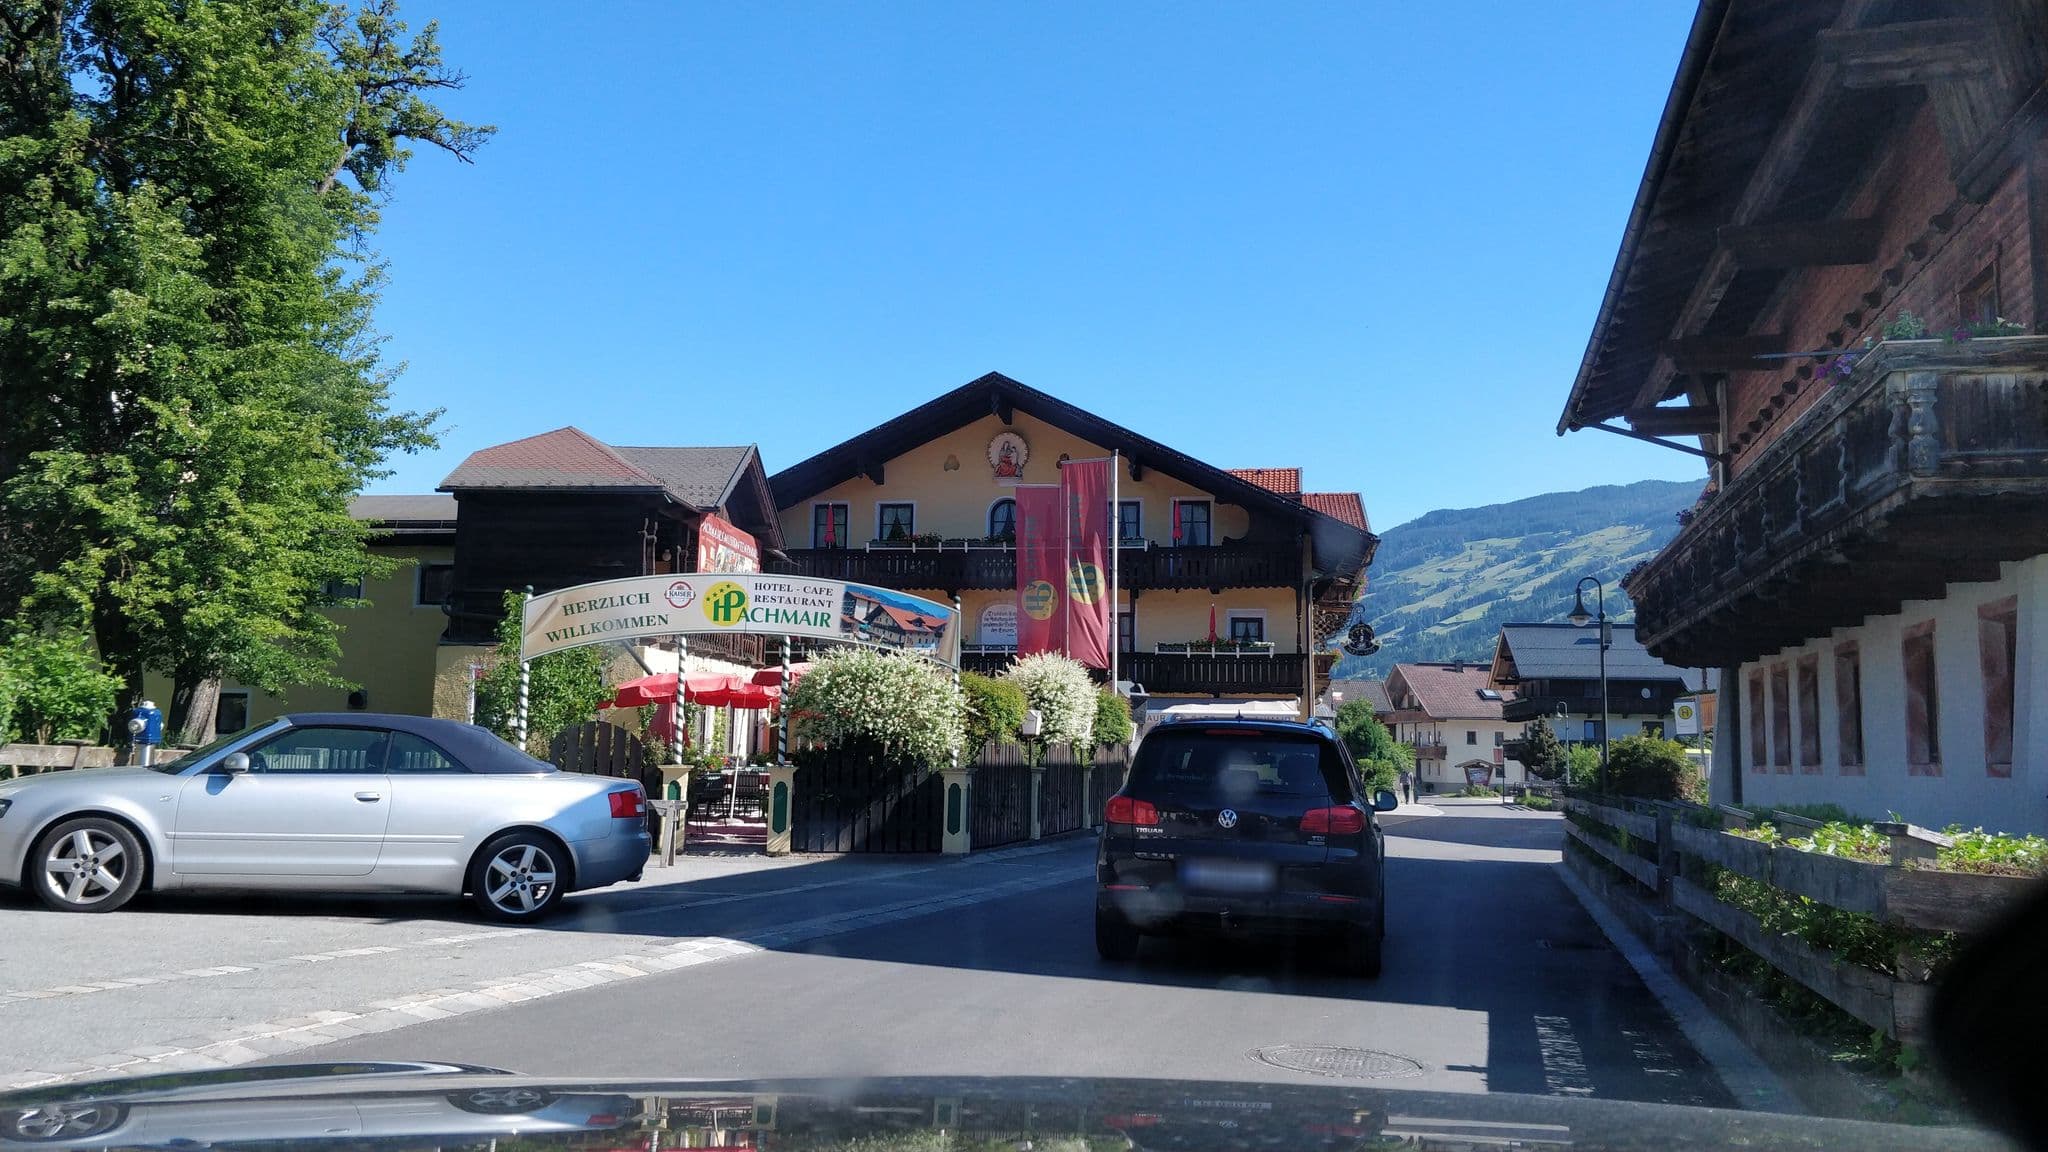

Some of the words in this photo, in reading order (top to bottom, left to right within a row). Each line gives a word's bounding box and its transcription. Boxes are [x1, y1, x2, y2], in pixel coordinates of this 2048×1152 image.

[668, 589, 692, 598] KAISER
[754, 582, 793, 593] HOTEL
[803, 585, 834, 596] CAFE
[562, 592, 651, 617] HERZLICH
[754, 594, 834, 608] RESTAURANT
[545, 614, 670, 643] WILLKOMMEN
